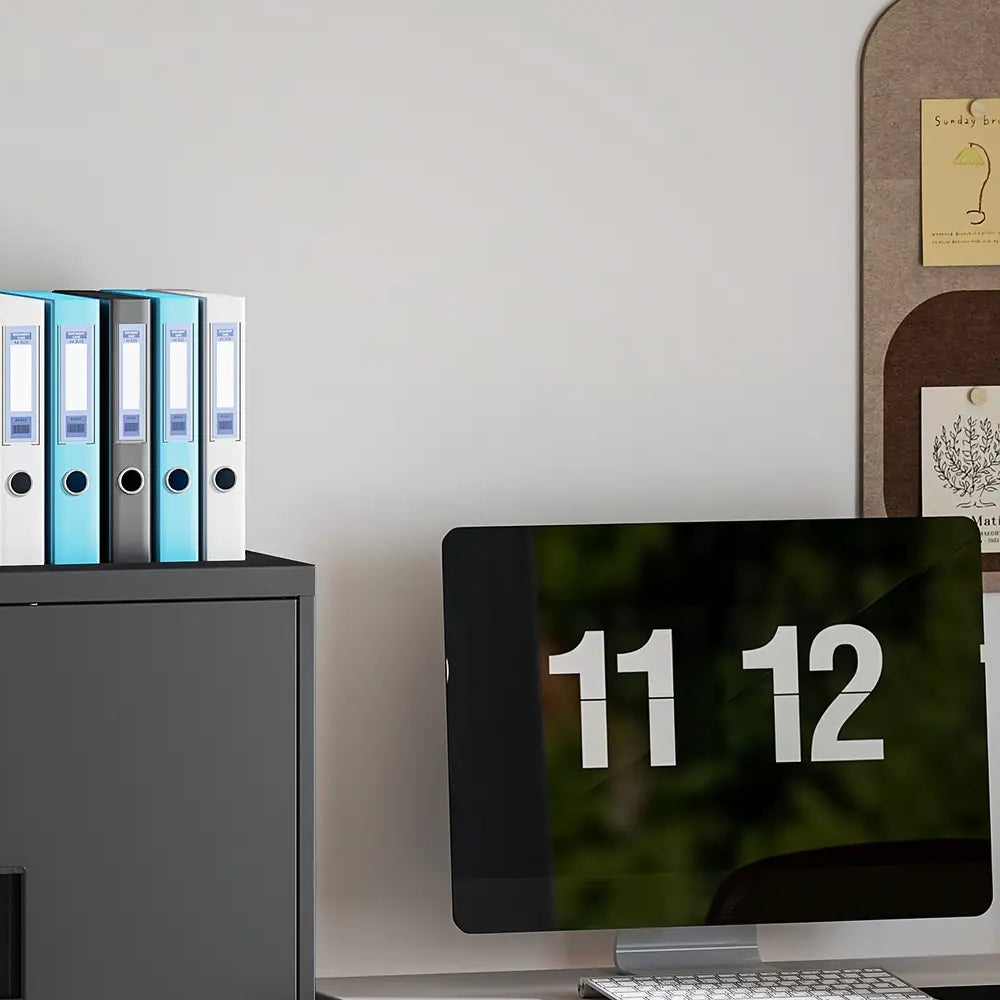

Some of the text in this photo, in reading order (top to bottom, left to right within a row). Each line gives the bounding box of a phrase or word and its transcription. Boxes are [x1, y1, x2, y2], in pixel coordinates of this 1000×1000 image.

[935, 114, 976, 128] Sunday
[548, 623, 884, 768] 11 12
